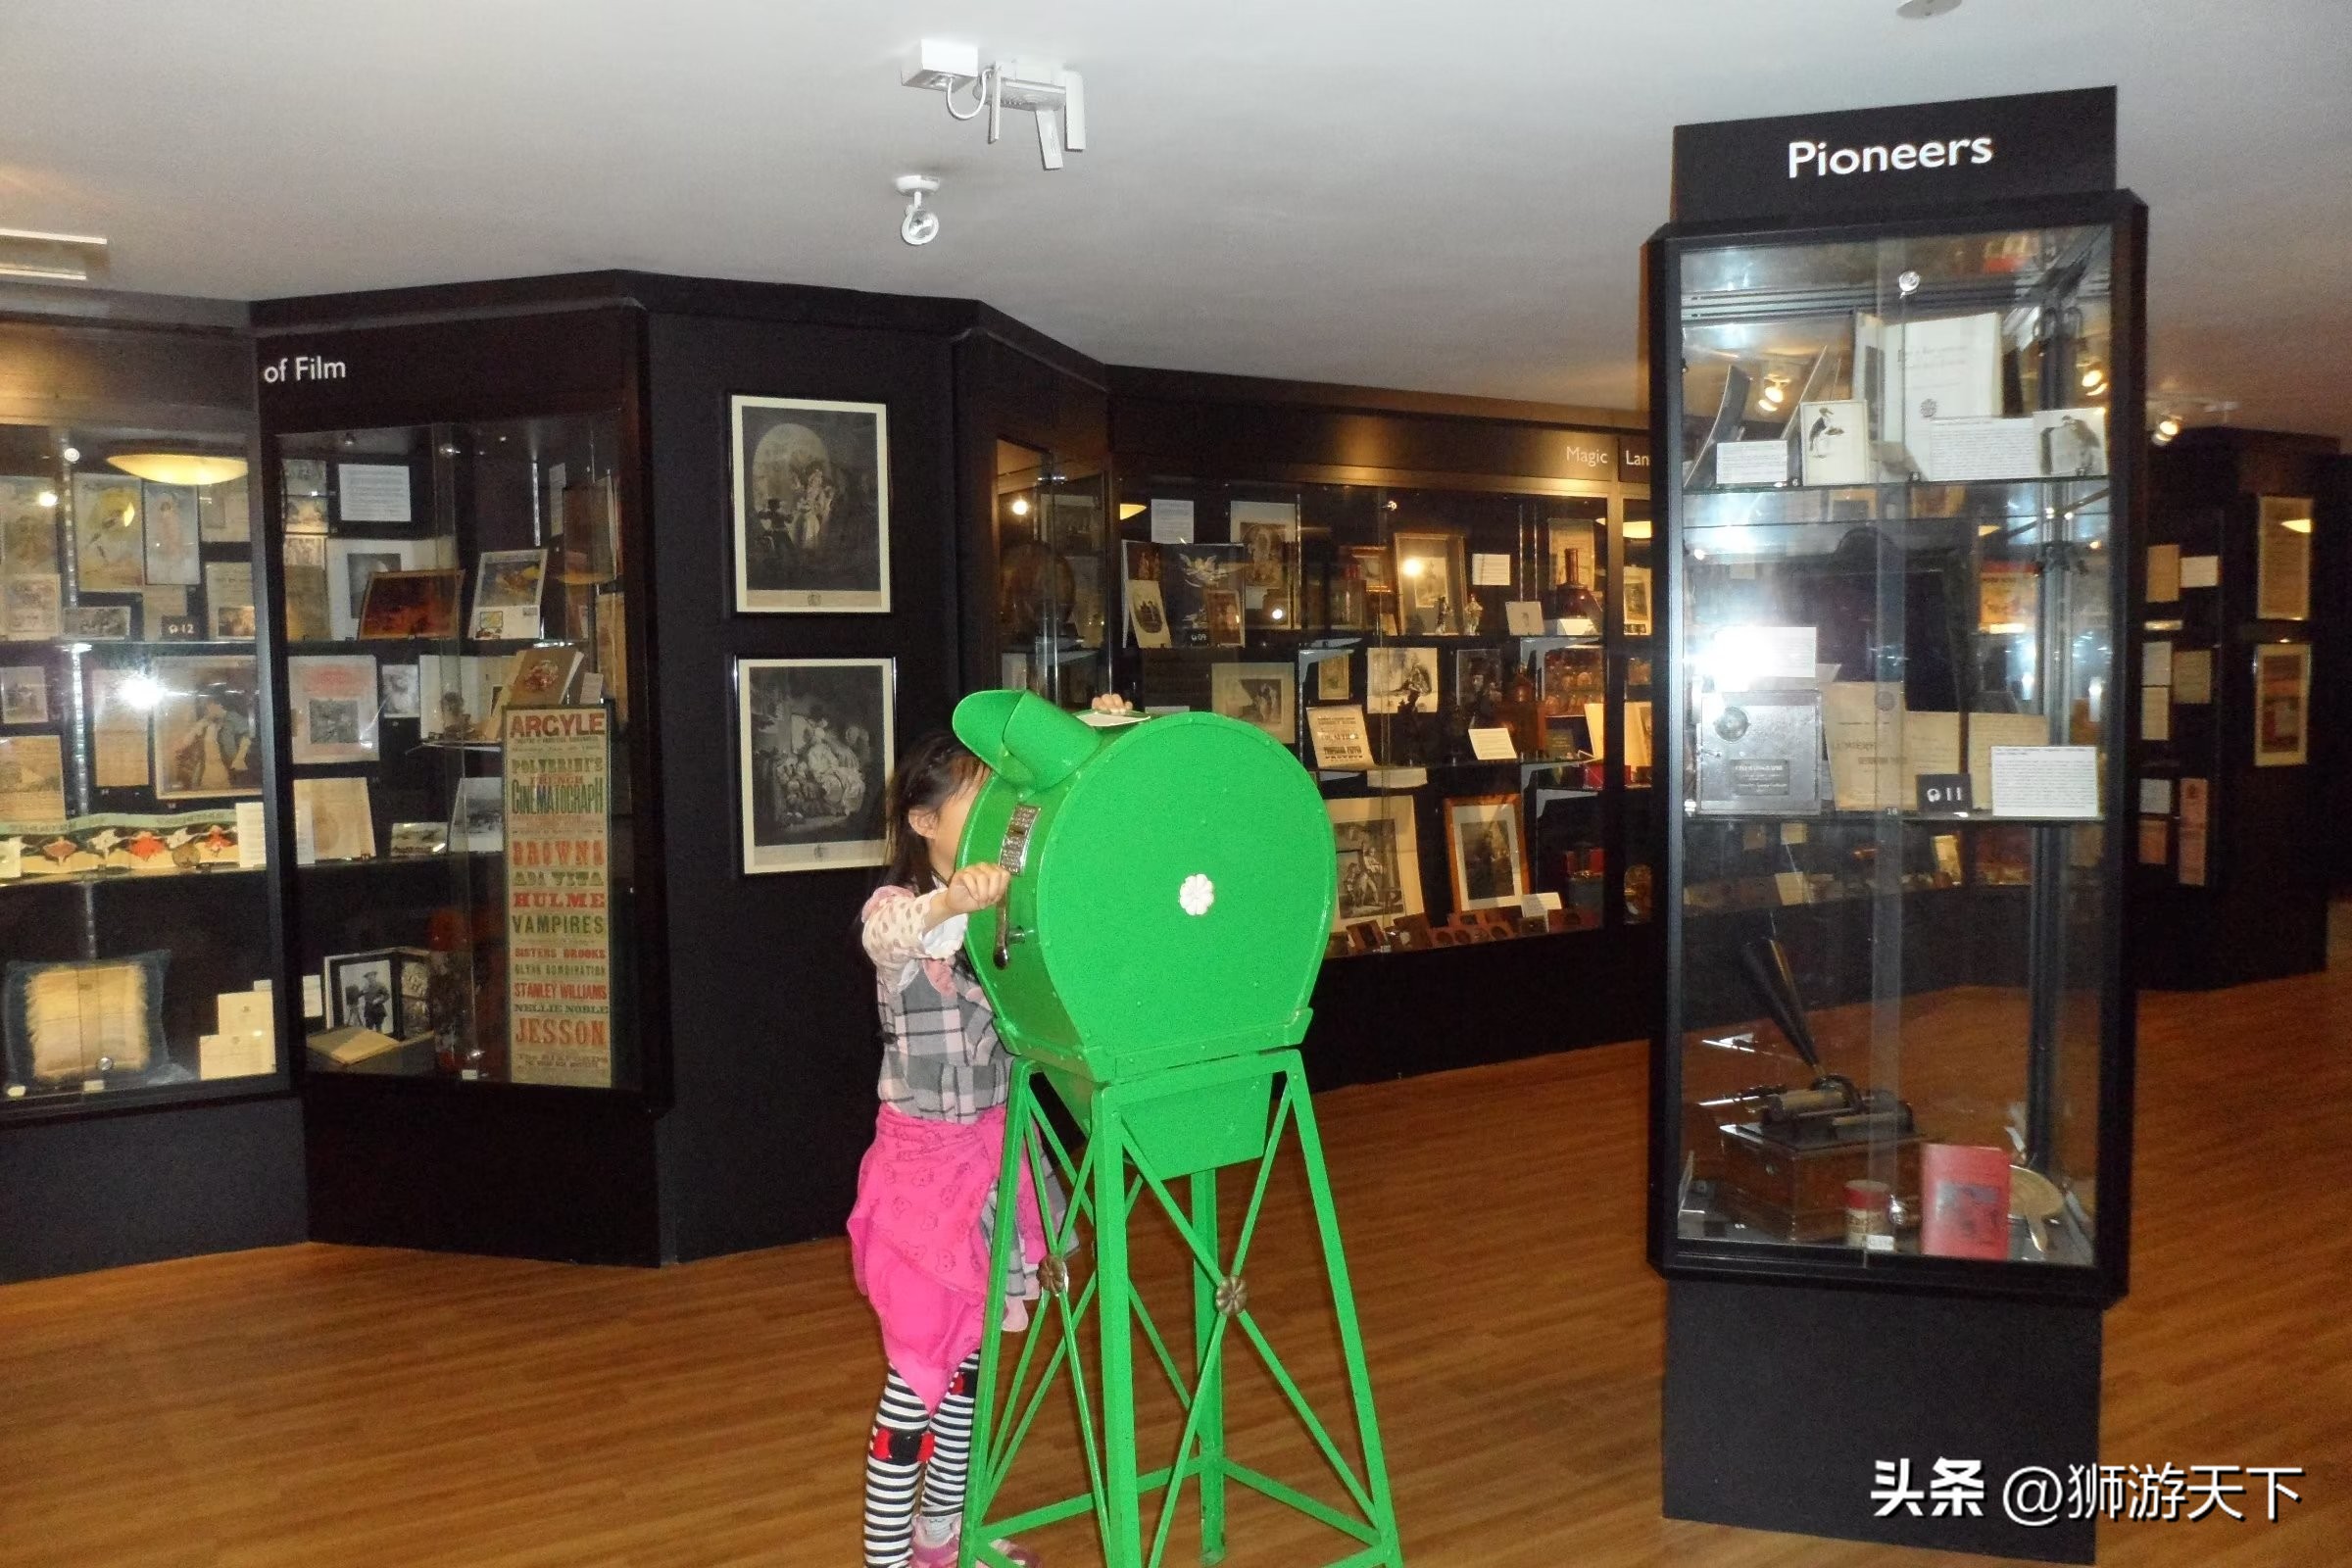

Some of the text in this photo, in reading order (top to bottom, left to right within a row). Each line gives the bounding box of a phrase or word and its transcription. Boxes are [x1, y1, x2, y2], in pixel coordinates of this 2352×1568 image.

[1788, 136, 1993, 179] Pioneers
[264, 355, 347, 384] of Film
[1565, 446, 1650, 467] Magic Lan
[509, 712, 606, 738] ARGYLE
[513, 892, 606, 908] HULME
[512, 914, 605, 934] VAMPIRES
[514, 981, 608, 1001] STANLEY WILLIAMS
[514, 1003, 609, 1014] NELLIE NOBLE
[514, 1017, 606, 1047] JESSON
